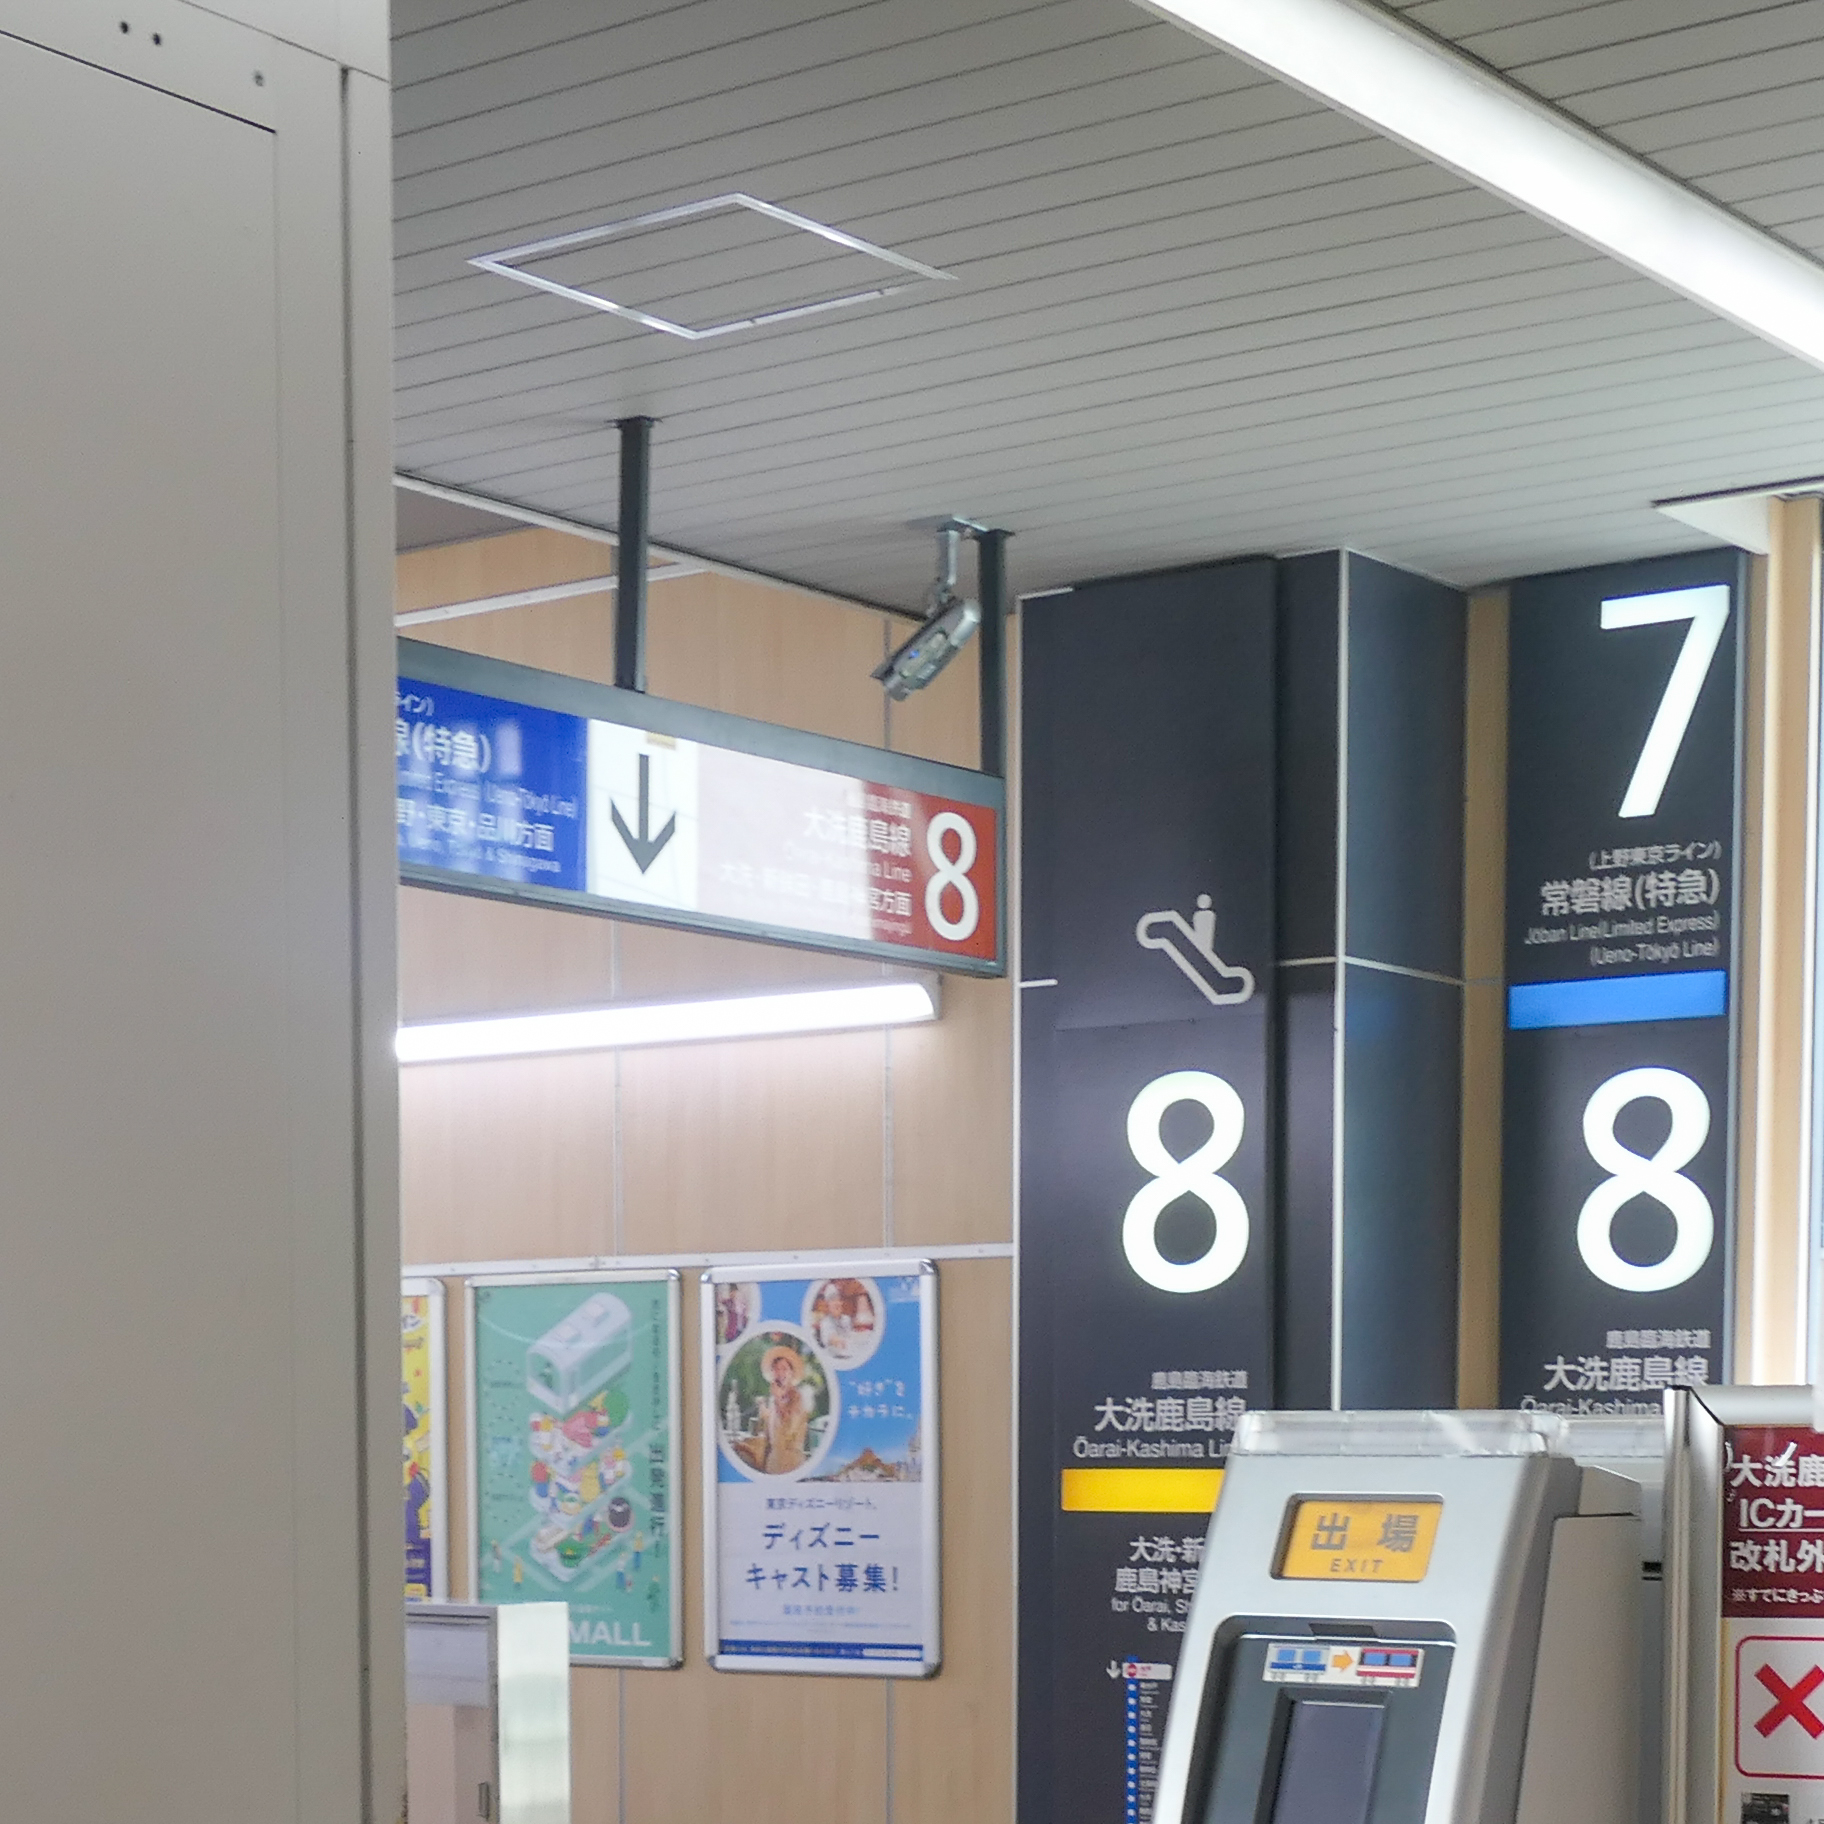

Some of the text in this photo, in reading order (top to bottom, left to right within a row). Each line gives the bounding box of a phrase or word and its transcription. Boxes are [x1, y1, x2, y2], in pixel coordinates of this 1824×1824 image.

[1599, 582, 1732, 819] 7
[924, 810, 980, 942] 8
[1540, 868, 1721, 916] 常磐線(特急)
[1121, 1070, 1250, 1294] 8
[1576, 1066, 1715, 1293] 8
[1542, 1355, 1710, 1392] 大洗鹿島線
[1093, 1395, 1247, 1433] 大洗鹿島線
[762, 1522, 880, 1551] ディズニー
[1310, 1512, 1421, 1553] 出場
[745, 1562, 899, 1593] キャスト募集!
[1329, 1557, 1385, 1574] EXIT
